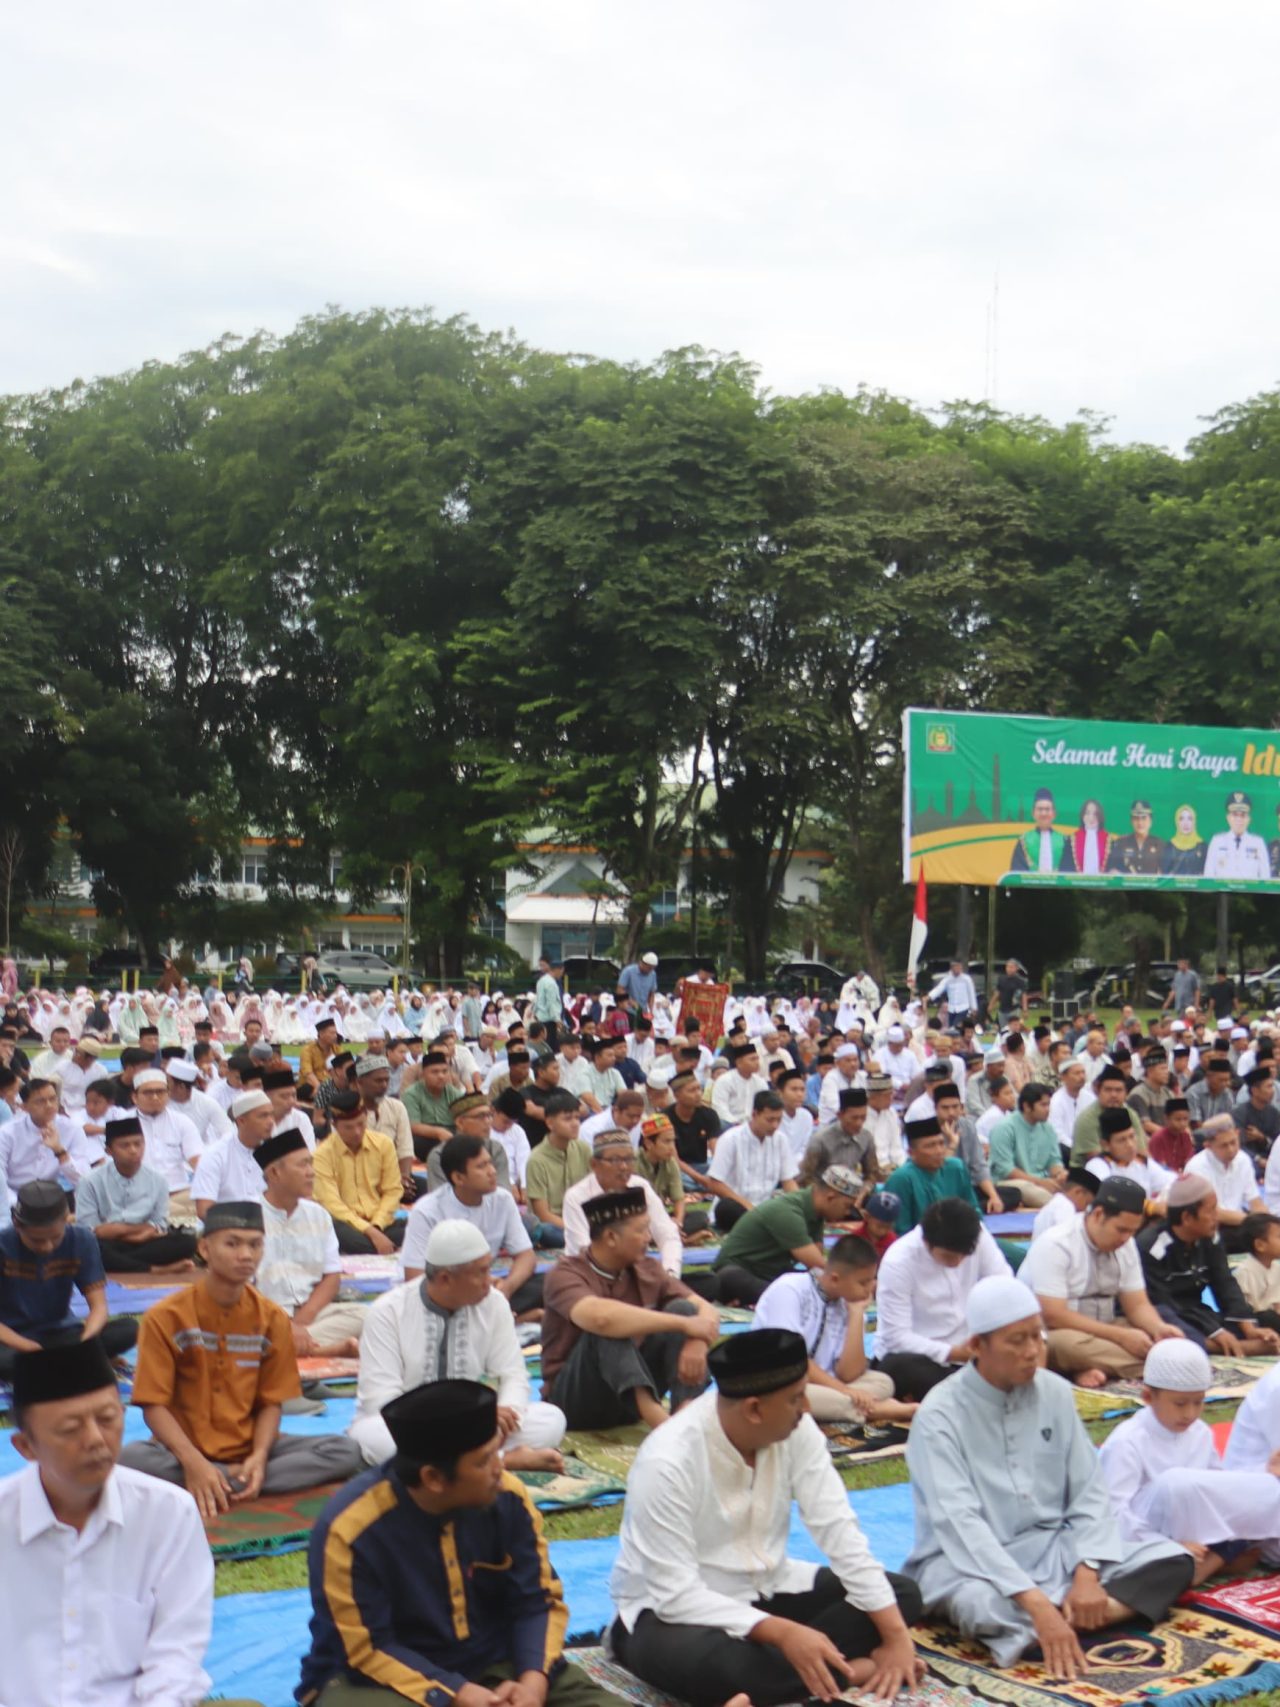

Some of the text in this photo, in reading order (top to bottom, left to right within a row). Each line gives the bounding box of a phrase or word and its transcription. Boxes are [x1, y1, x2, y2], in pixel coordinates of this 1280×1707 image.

[1032, 738, 1118, 767] Selamat
[1121, 742, 1174, 769] Hari
[1178, 745, 1239, 778] Raya
